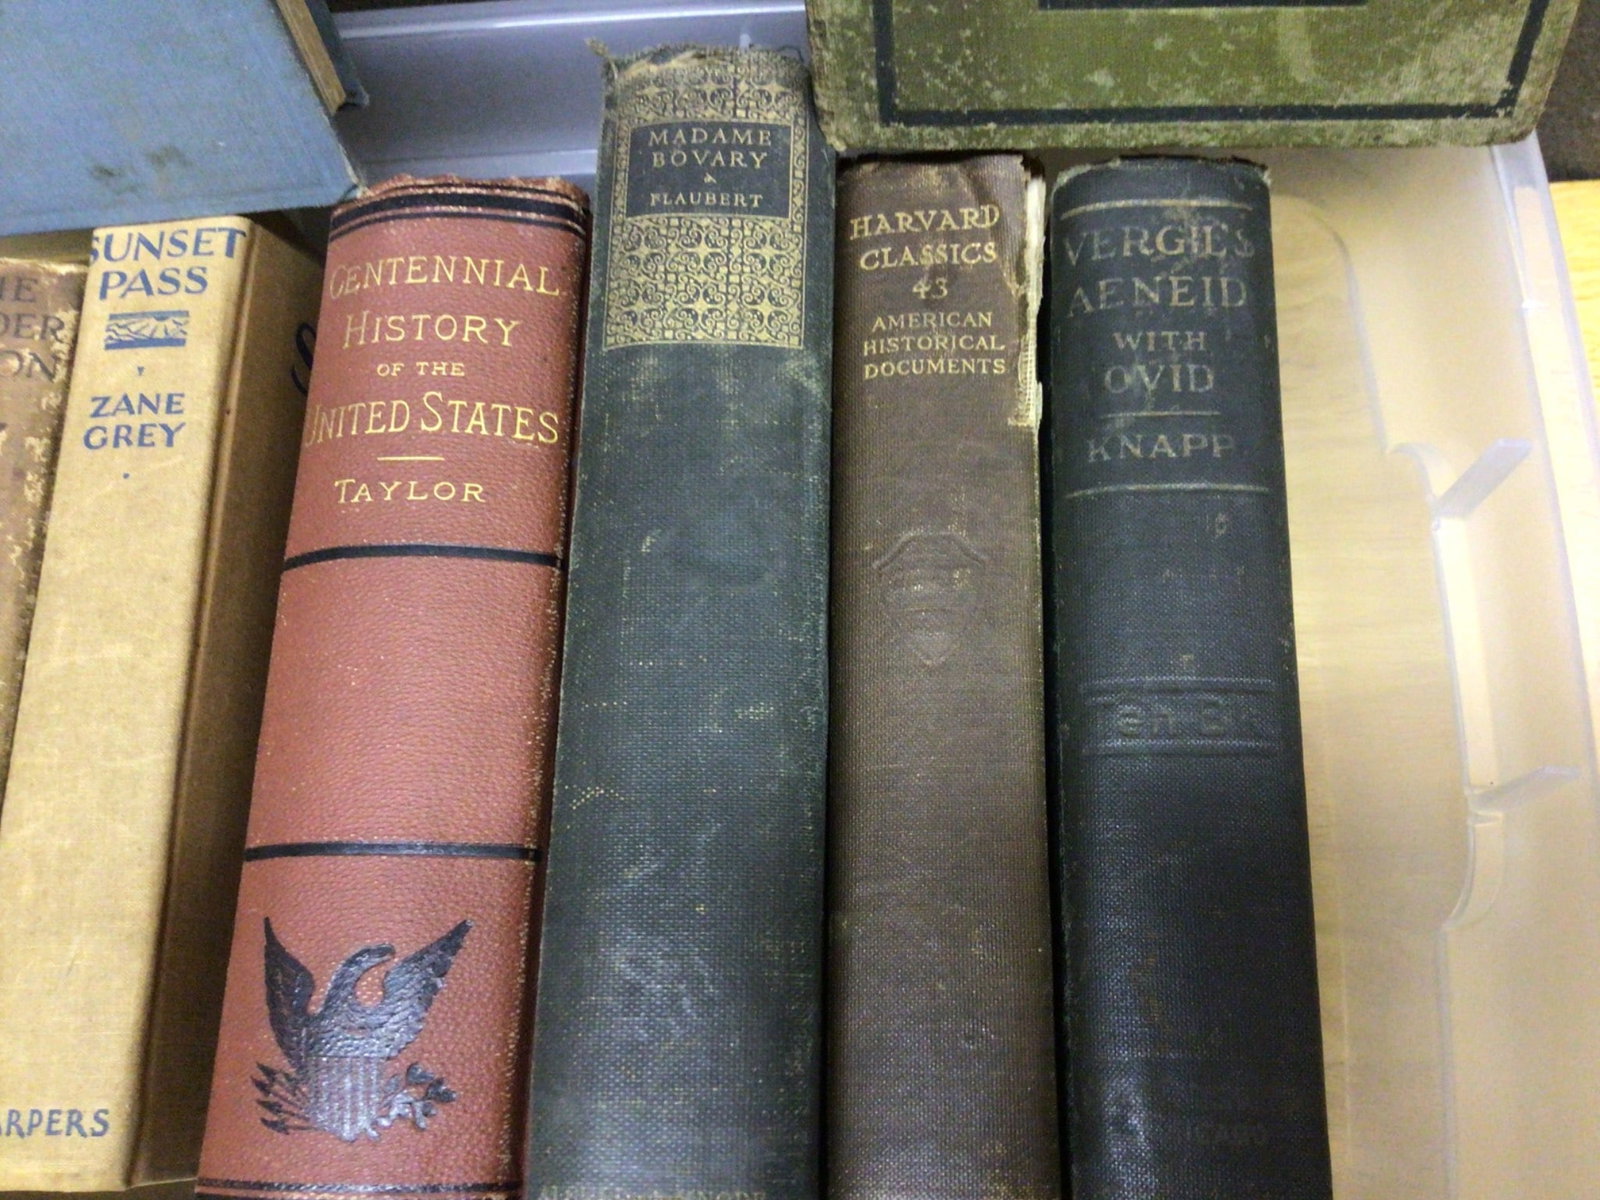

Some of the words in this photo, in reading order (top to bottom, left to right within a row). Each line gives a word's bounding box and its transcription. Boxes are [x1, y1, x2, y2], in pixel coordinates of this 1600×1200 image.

[648, 127, 772, 147] MADAME
[652, 149, 768, 169] BOVARY
[650, 191, 764, 208] FLAUBERT
[850, 203, 1000, 241] HARVARD
[859, 241, 998, 271] CLASSICS
[98, 266, 208, 300] PASS
[329, 255, 560, 300] CENTENNIAL
[912, 276, 949, 300] 43
[1066, 275, 1248, 319] AENEID
[342, 309, 521, 350] HISTORY
[871, 311, 994, 333] AMERICAN
[863, 333, 1006, 357] HISTORICAL
[1111, 330, 1207, 351] WITH
[376, 362, 404, 377] OF
[416, 361, 466, 377] THE
[864, 357, 1007, 381] DOCUMENTS
[1103, 363, 1214, 394] OVID
[90, 392, 186, 418] ZANE
[420, 391, 559, 444] STATES
[82, 422, 187, 450] GREY
[1086, 433, 1235, 463] KNAPP
[334, 479, 486, 504] TAYLOR
[0, 1108, 110, 1139] RPERS
